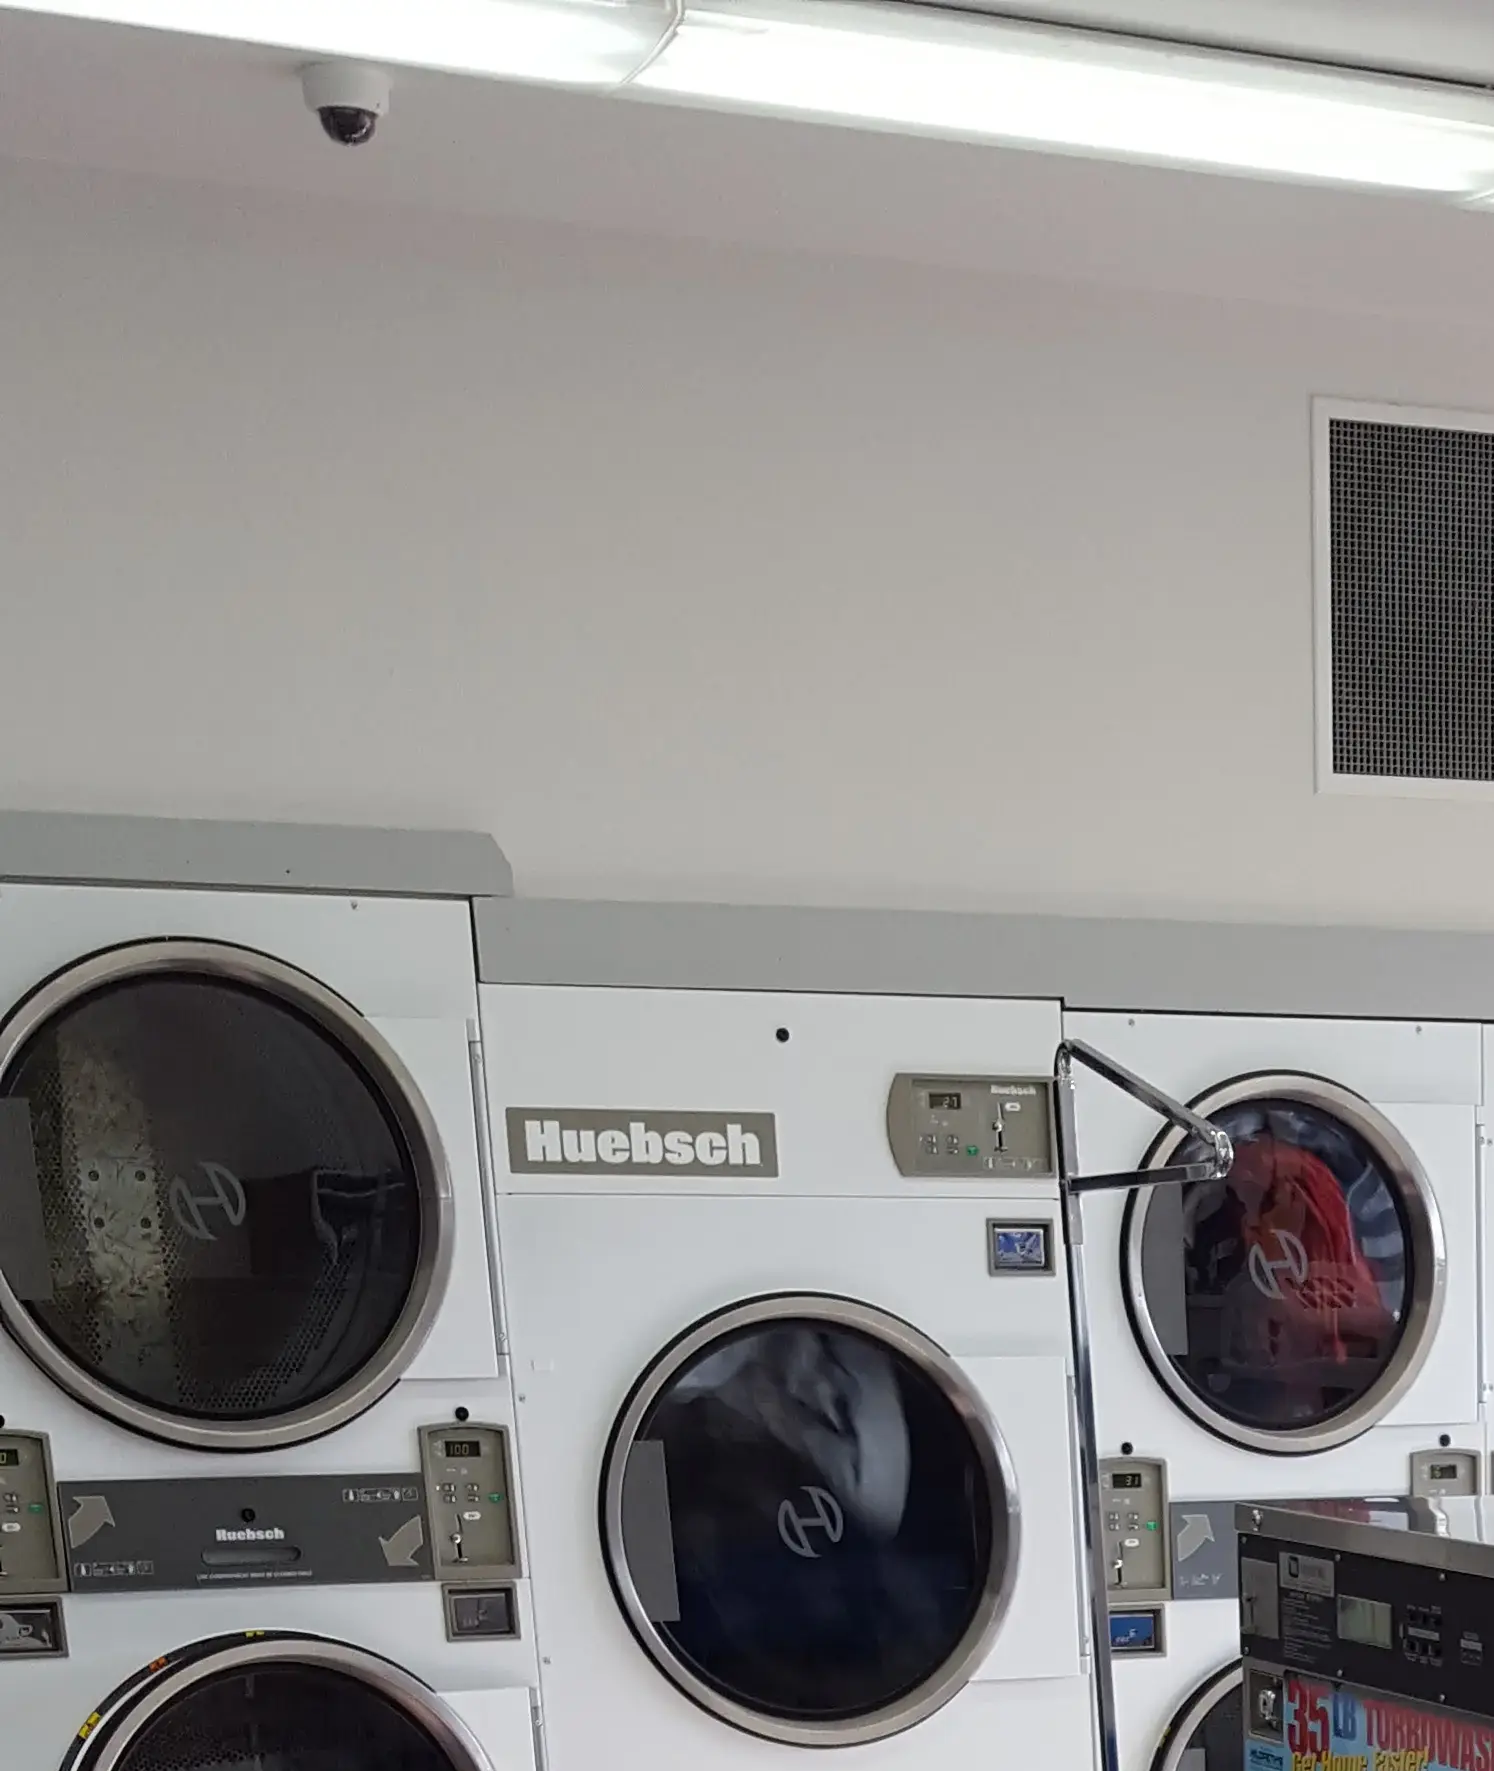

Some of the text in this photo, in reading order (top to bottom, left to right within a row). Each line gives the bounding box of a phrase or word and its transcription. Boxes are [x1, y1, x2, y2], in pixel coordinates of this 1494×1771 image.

[524, 1120, 761, 1166] Huebsch
[216, 1527, 285, 1541] Huebsch
[1287, 1680, 1330, 1763] 35
[1333, 1693, 1358, 1740] LB
